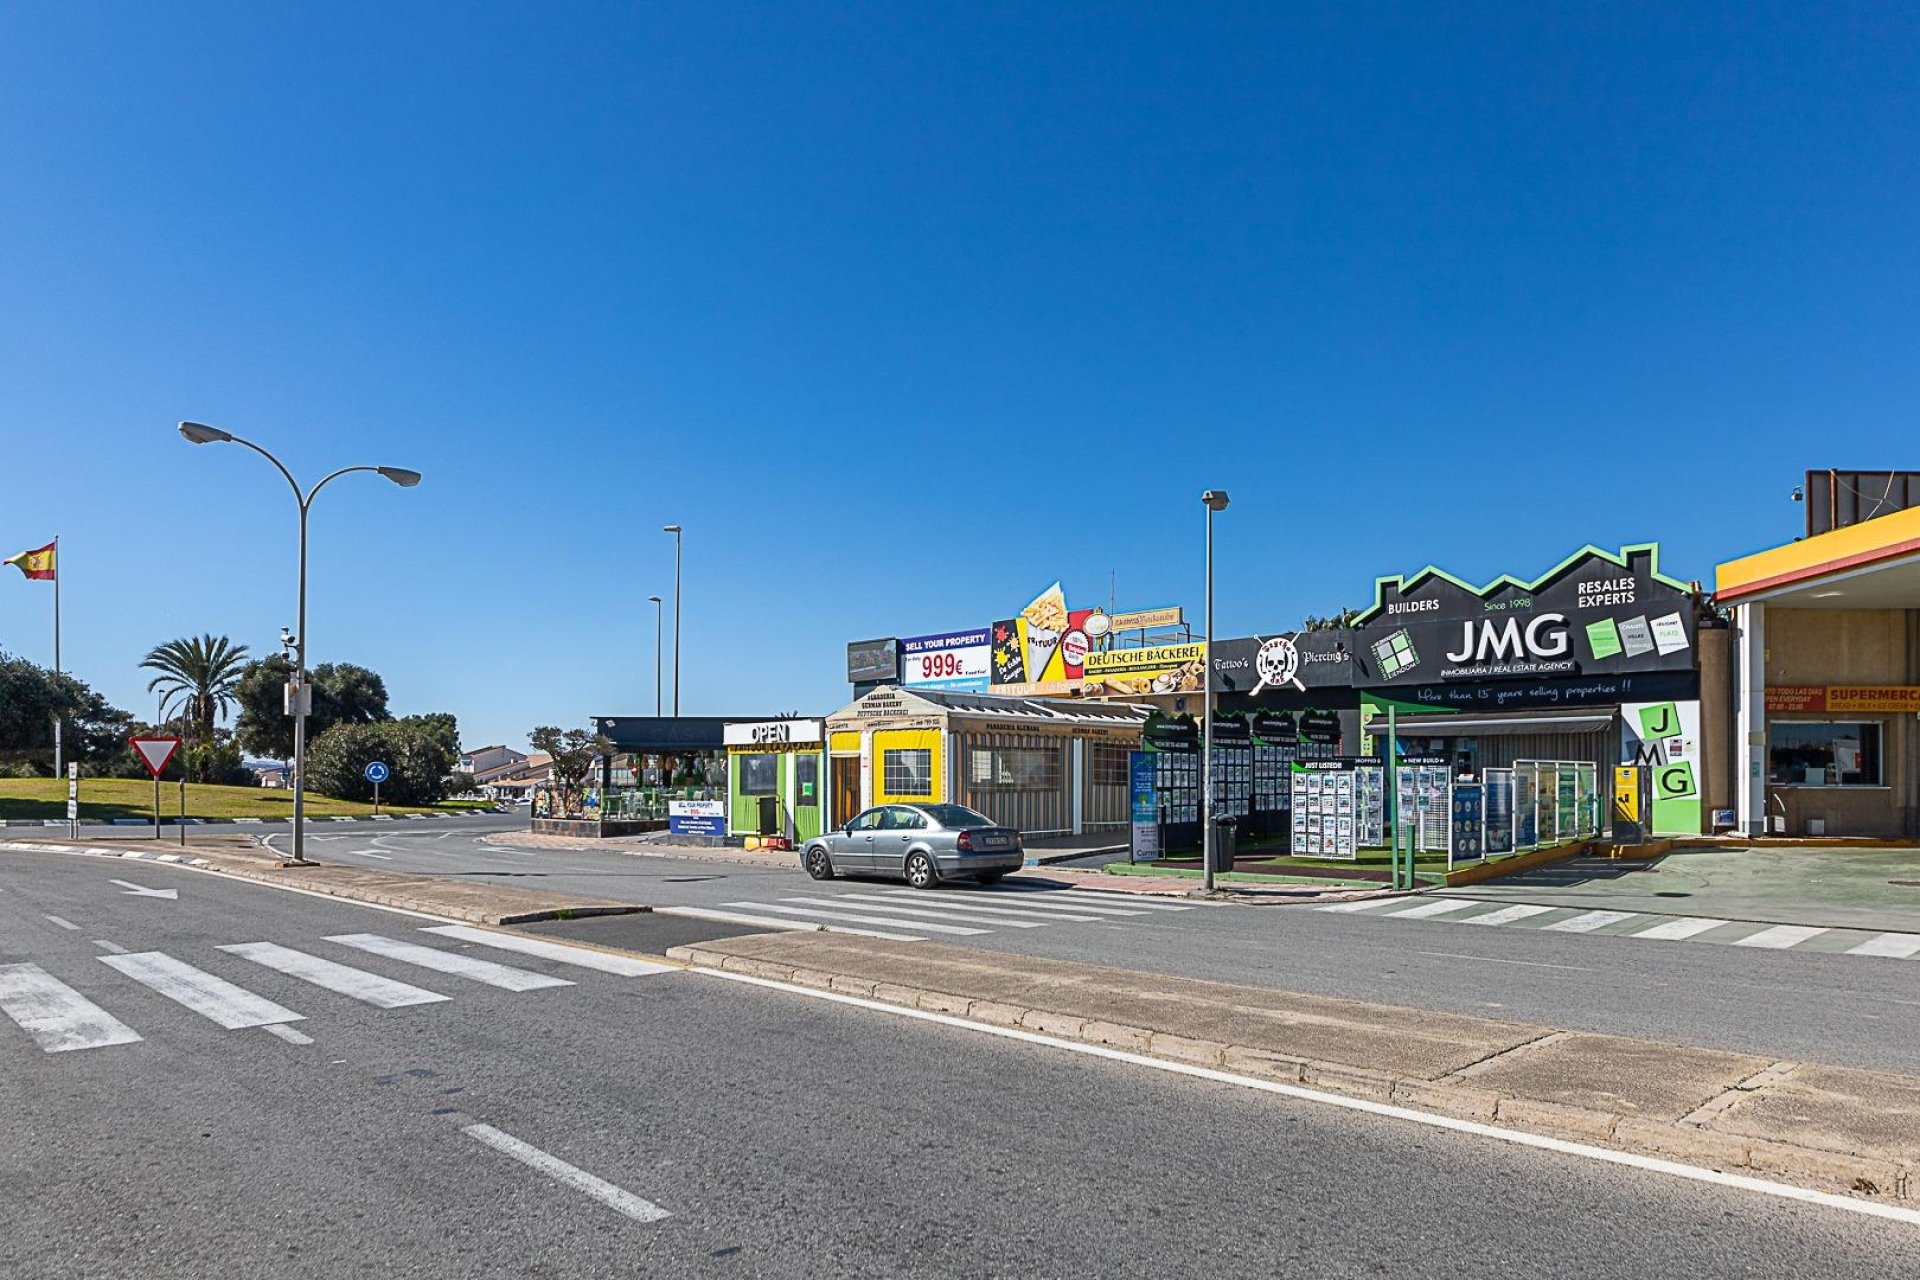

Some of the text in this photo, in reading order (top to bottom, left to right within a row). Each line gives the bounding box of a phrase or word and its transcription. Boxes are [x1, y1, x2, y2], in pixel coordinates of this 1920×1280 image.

[1578, 577, 1635, 594] RESALES
[1388, 599, 1439, 614] BUILDERS
[1484, 599, 1531, 611] Since 1998
[1578, 591, 1635, 608] EXPERTS
[905, 634, 986, 651] SELL YOUR PROPERTY
[1446, 613, 1568, 663] JMG
[1088, 646, 1199, 665] DEUTSCHE BÄCKEREI
[922, 653, 963, 678] 999€
[1494, 665, 1512, 673] REAL
[1512, 664, 1537, 673] ESTATE
[1538, 661, 1573, 671] AGENCY
[1418, 689, 1442, 701] More
[1450, 689, 1473, 699] than
[1497, 690, 1523, 704] years
[1530, 686, 1559, 701] selling
[1566, 684, 1616, 700] properties
[862, 701, 881, 709] GERMAN
[751, 723, 789, 742] OPEN
[1633, 708, 1688, 794] J M G
